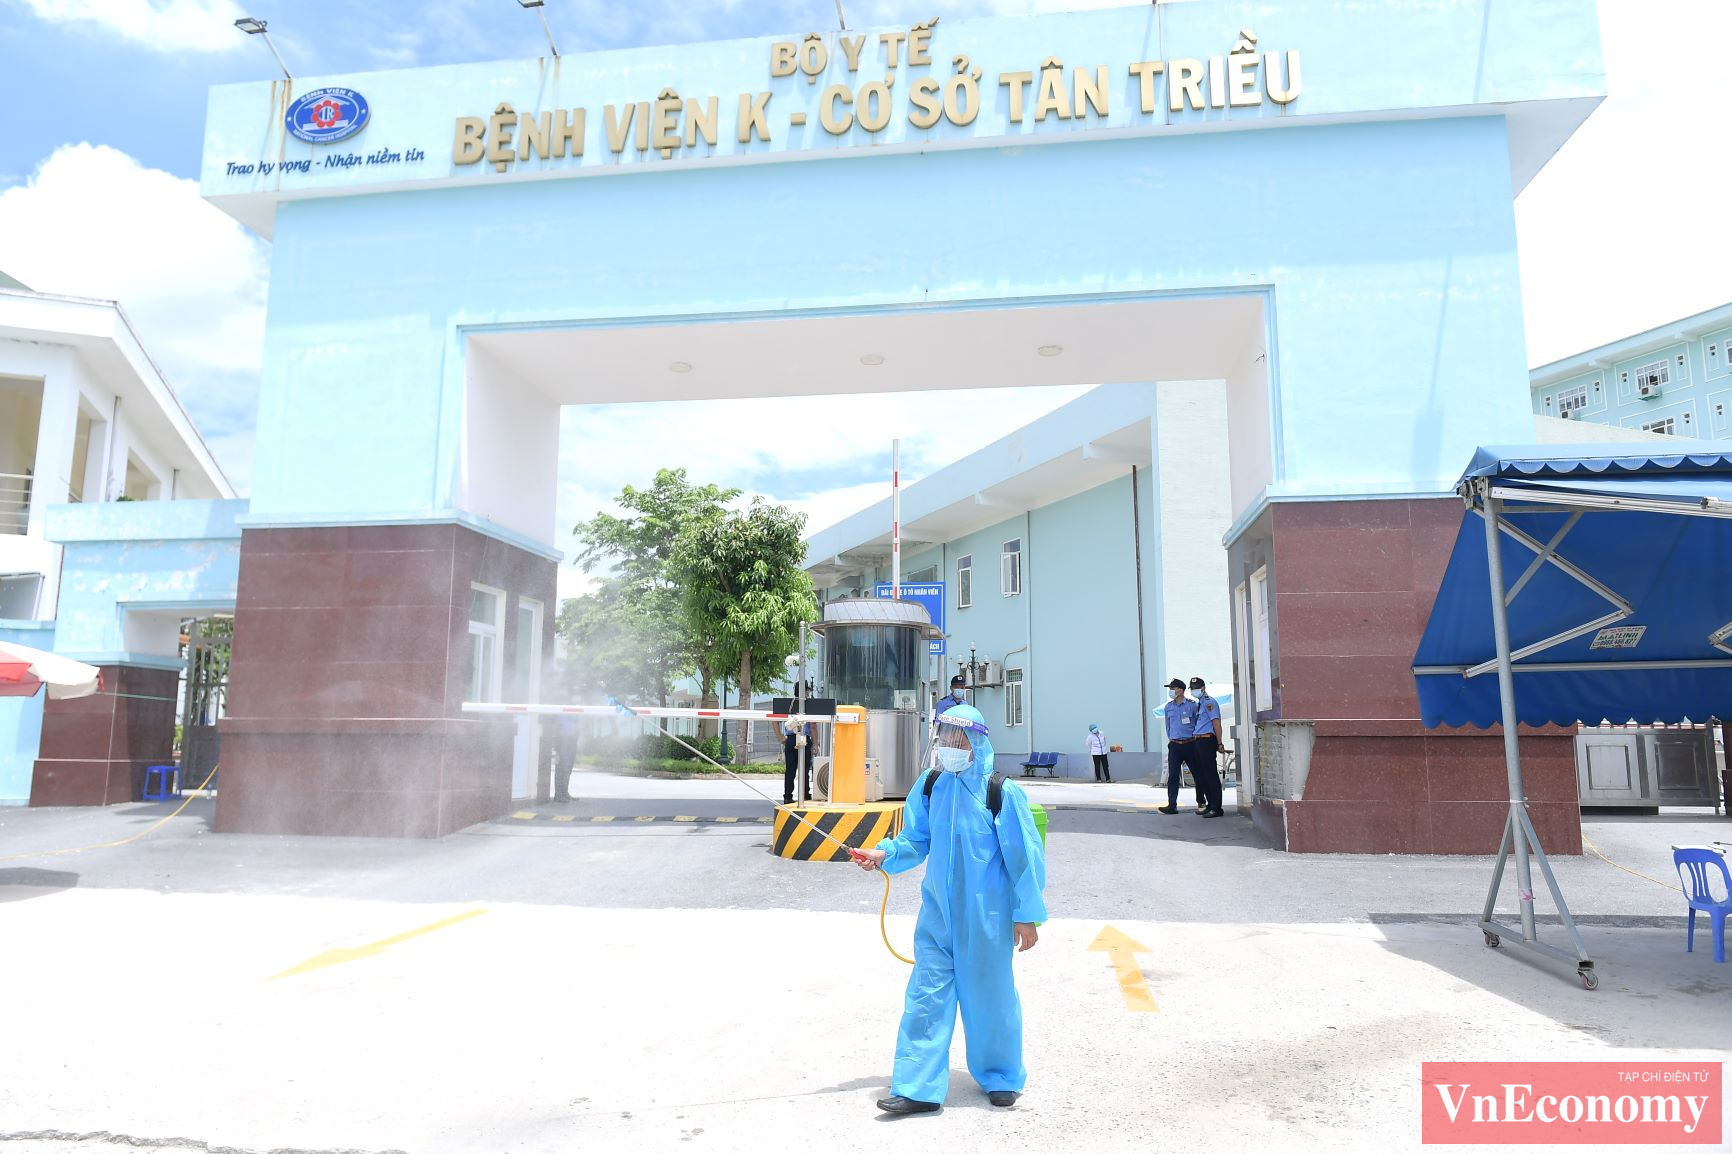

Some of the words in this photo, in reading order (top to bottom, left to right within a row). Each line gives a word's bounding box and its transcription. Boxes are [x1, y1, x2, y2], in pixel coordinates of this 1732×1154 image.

[771, 32, 827, 84] BỘ
[840, 34, 866, 72] Y
[880, 17, 940, 67] TẾ
[453, 102, 586, 172] BỆNH
[603, 87, 719, 160] VIỆN
[737, 92, 772, 143] K
[790, 112, 807, 126] -
[820, 67, 895, 135] CƠ
[908, 54, 982, 129] SỞ
[999, 56, 1109, 124] TÂN
[1129, 29, 1301, 114] TRIỀU
[226, 162, 255, 175] Trao
[257, 161, 275, 176] hy
[279, 160, 312, 174] vọng
[324, 153, 362, 169] Nhận
[366, 147, 401, 165] niềm
[405, 147, 425, 161] tin
[930, 642, 940, 650] ÁCH
